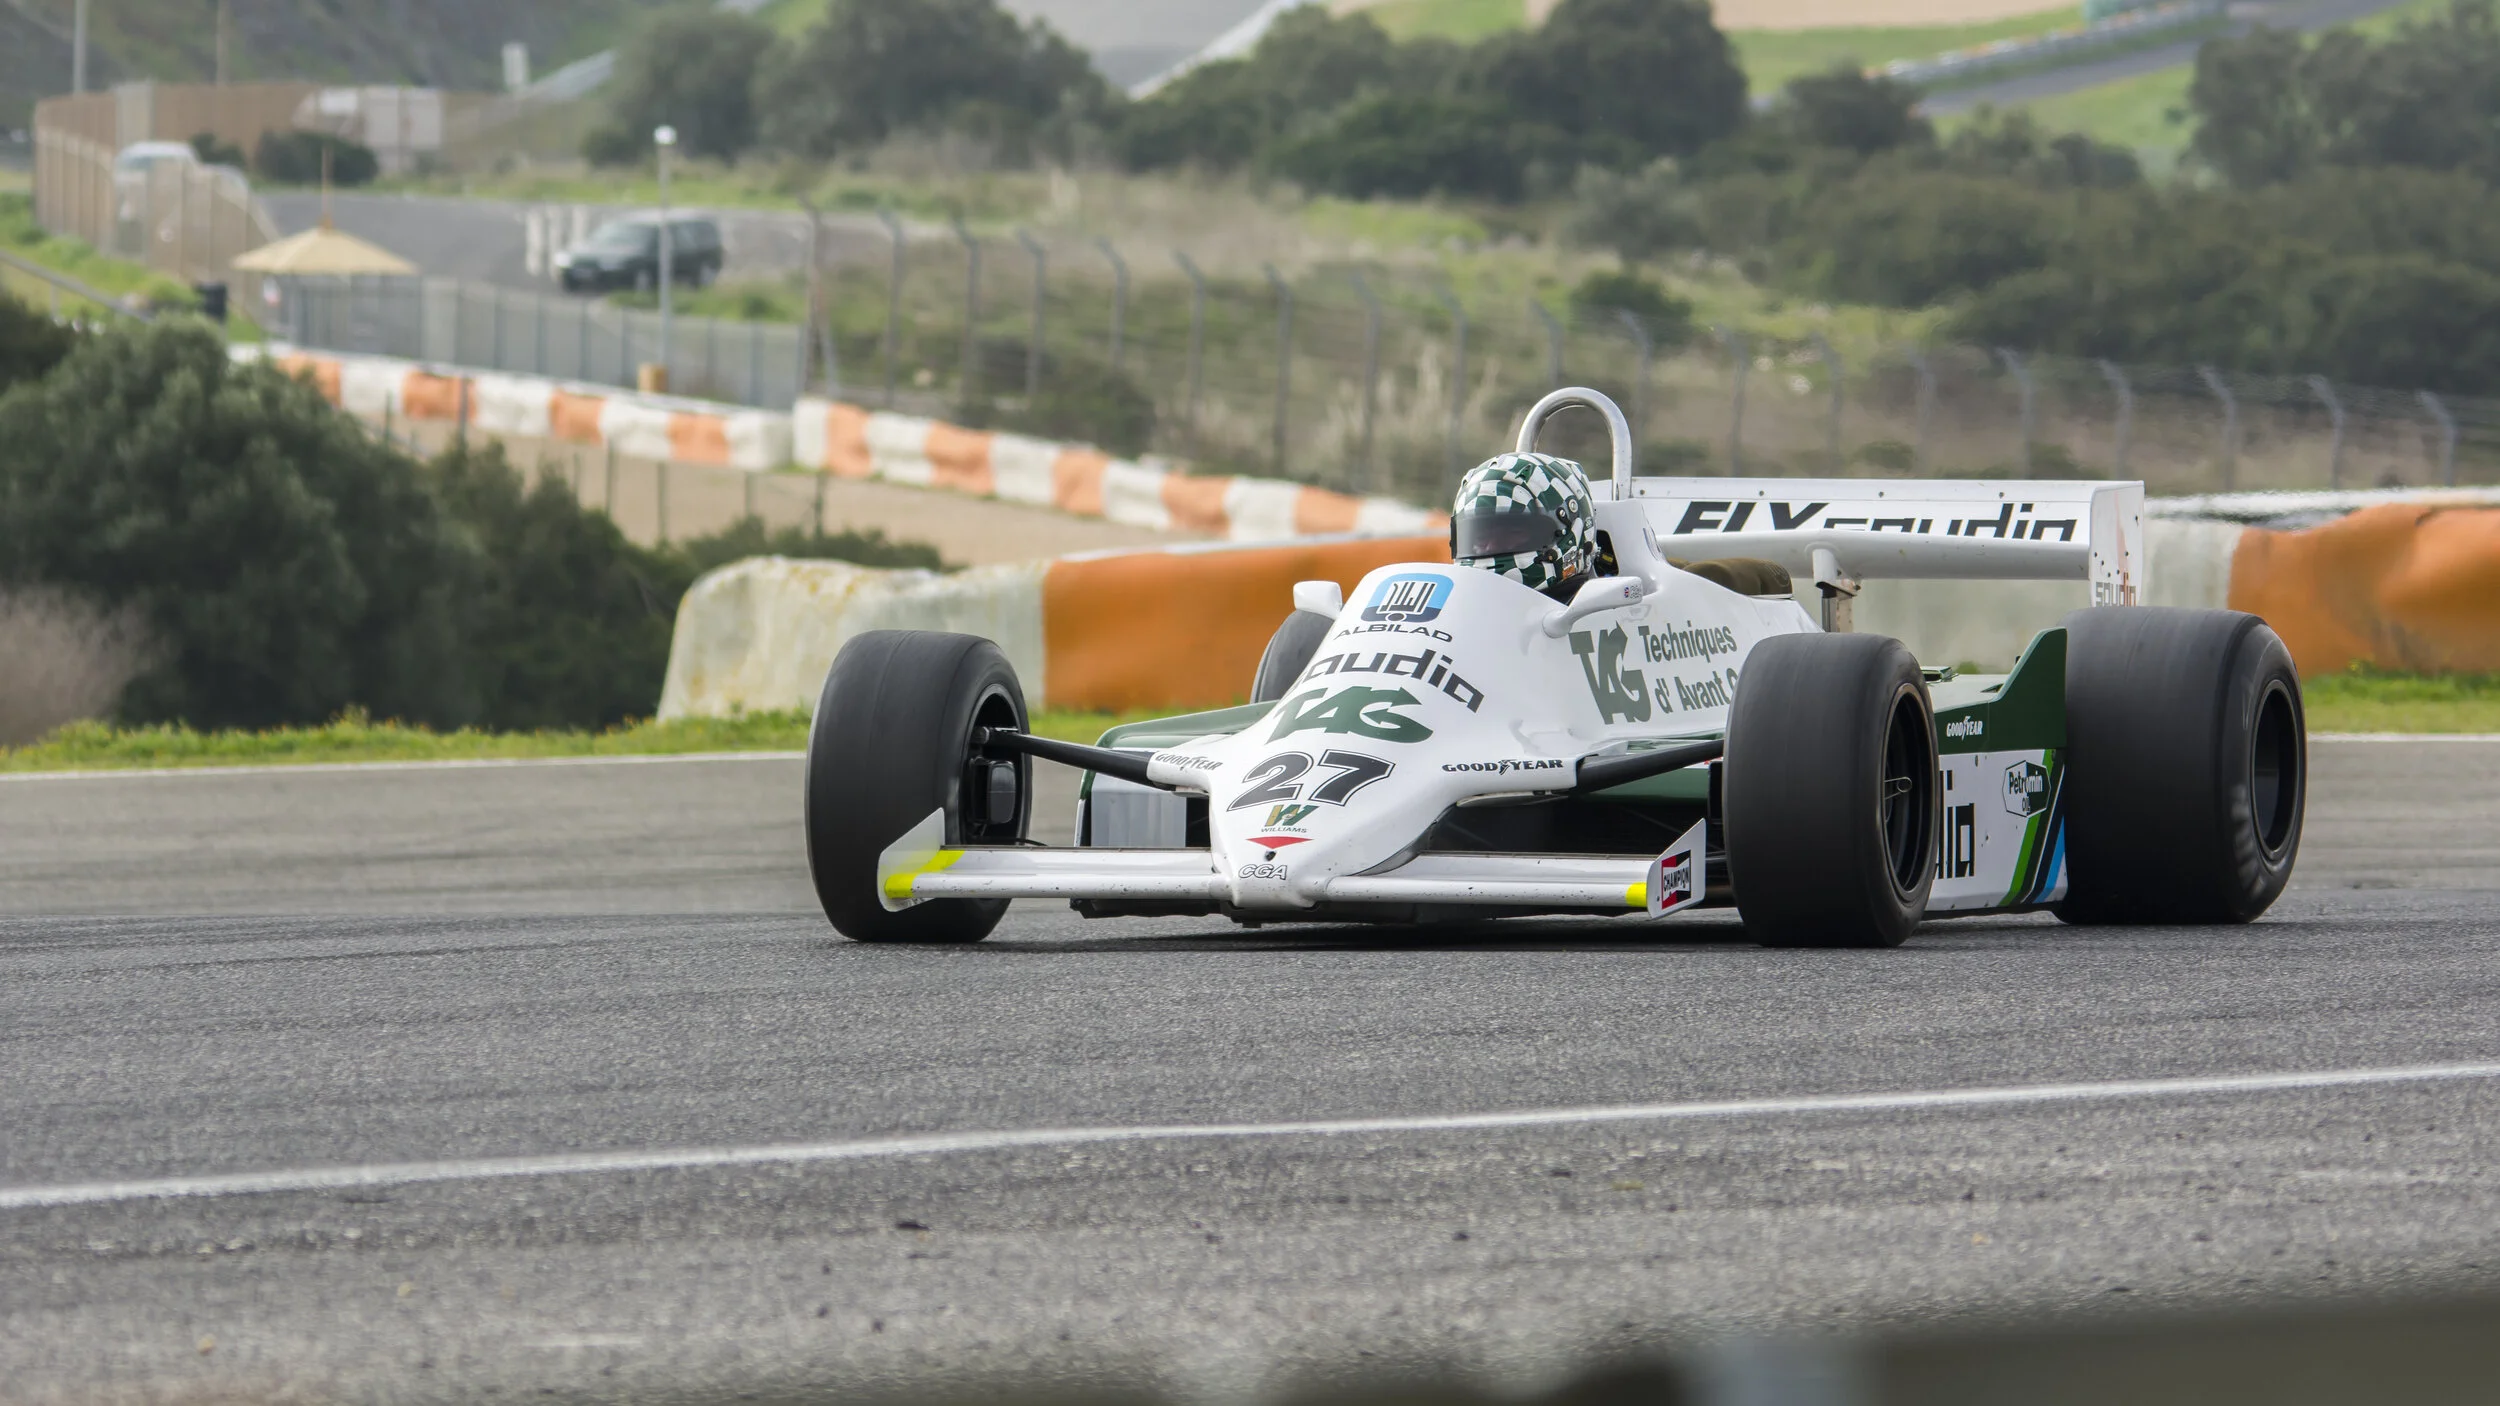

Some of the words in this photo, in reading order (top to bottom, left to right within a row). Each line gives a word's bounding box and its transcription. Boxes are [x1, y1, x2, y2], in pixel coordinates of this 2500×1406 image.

[1333, 623, 1453, 643] ALBILAD
[1638, 620, 1738, 663] Techniques
[1300, 648, 1485, 713] audia
[1569, 620, 1652, 725] TAG
[1674, 670, 1729, 711] Avant
[1946, 716, 1984, 739] GOODYEAR
[1155, 753, 1224, 771] GOODYEAR
[1441, 759, 1564, 775] GOODYEAR
[1226, 748, 1396, 813] 27
[2008, 770, 2043, 794] Petromin
[1260, 826, 1309, 834] WILLIAMS
[1238, 863, 1288, 881] CGA
[1663, 866, 1690, 893] CHAMPION
